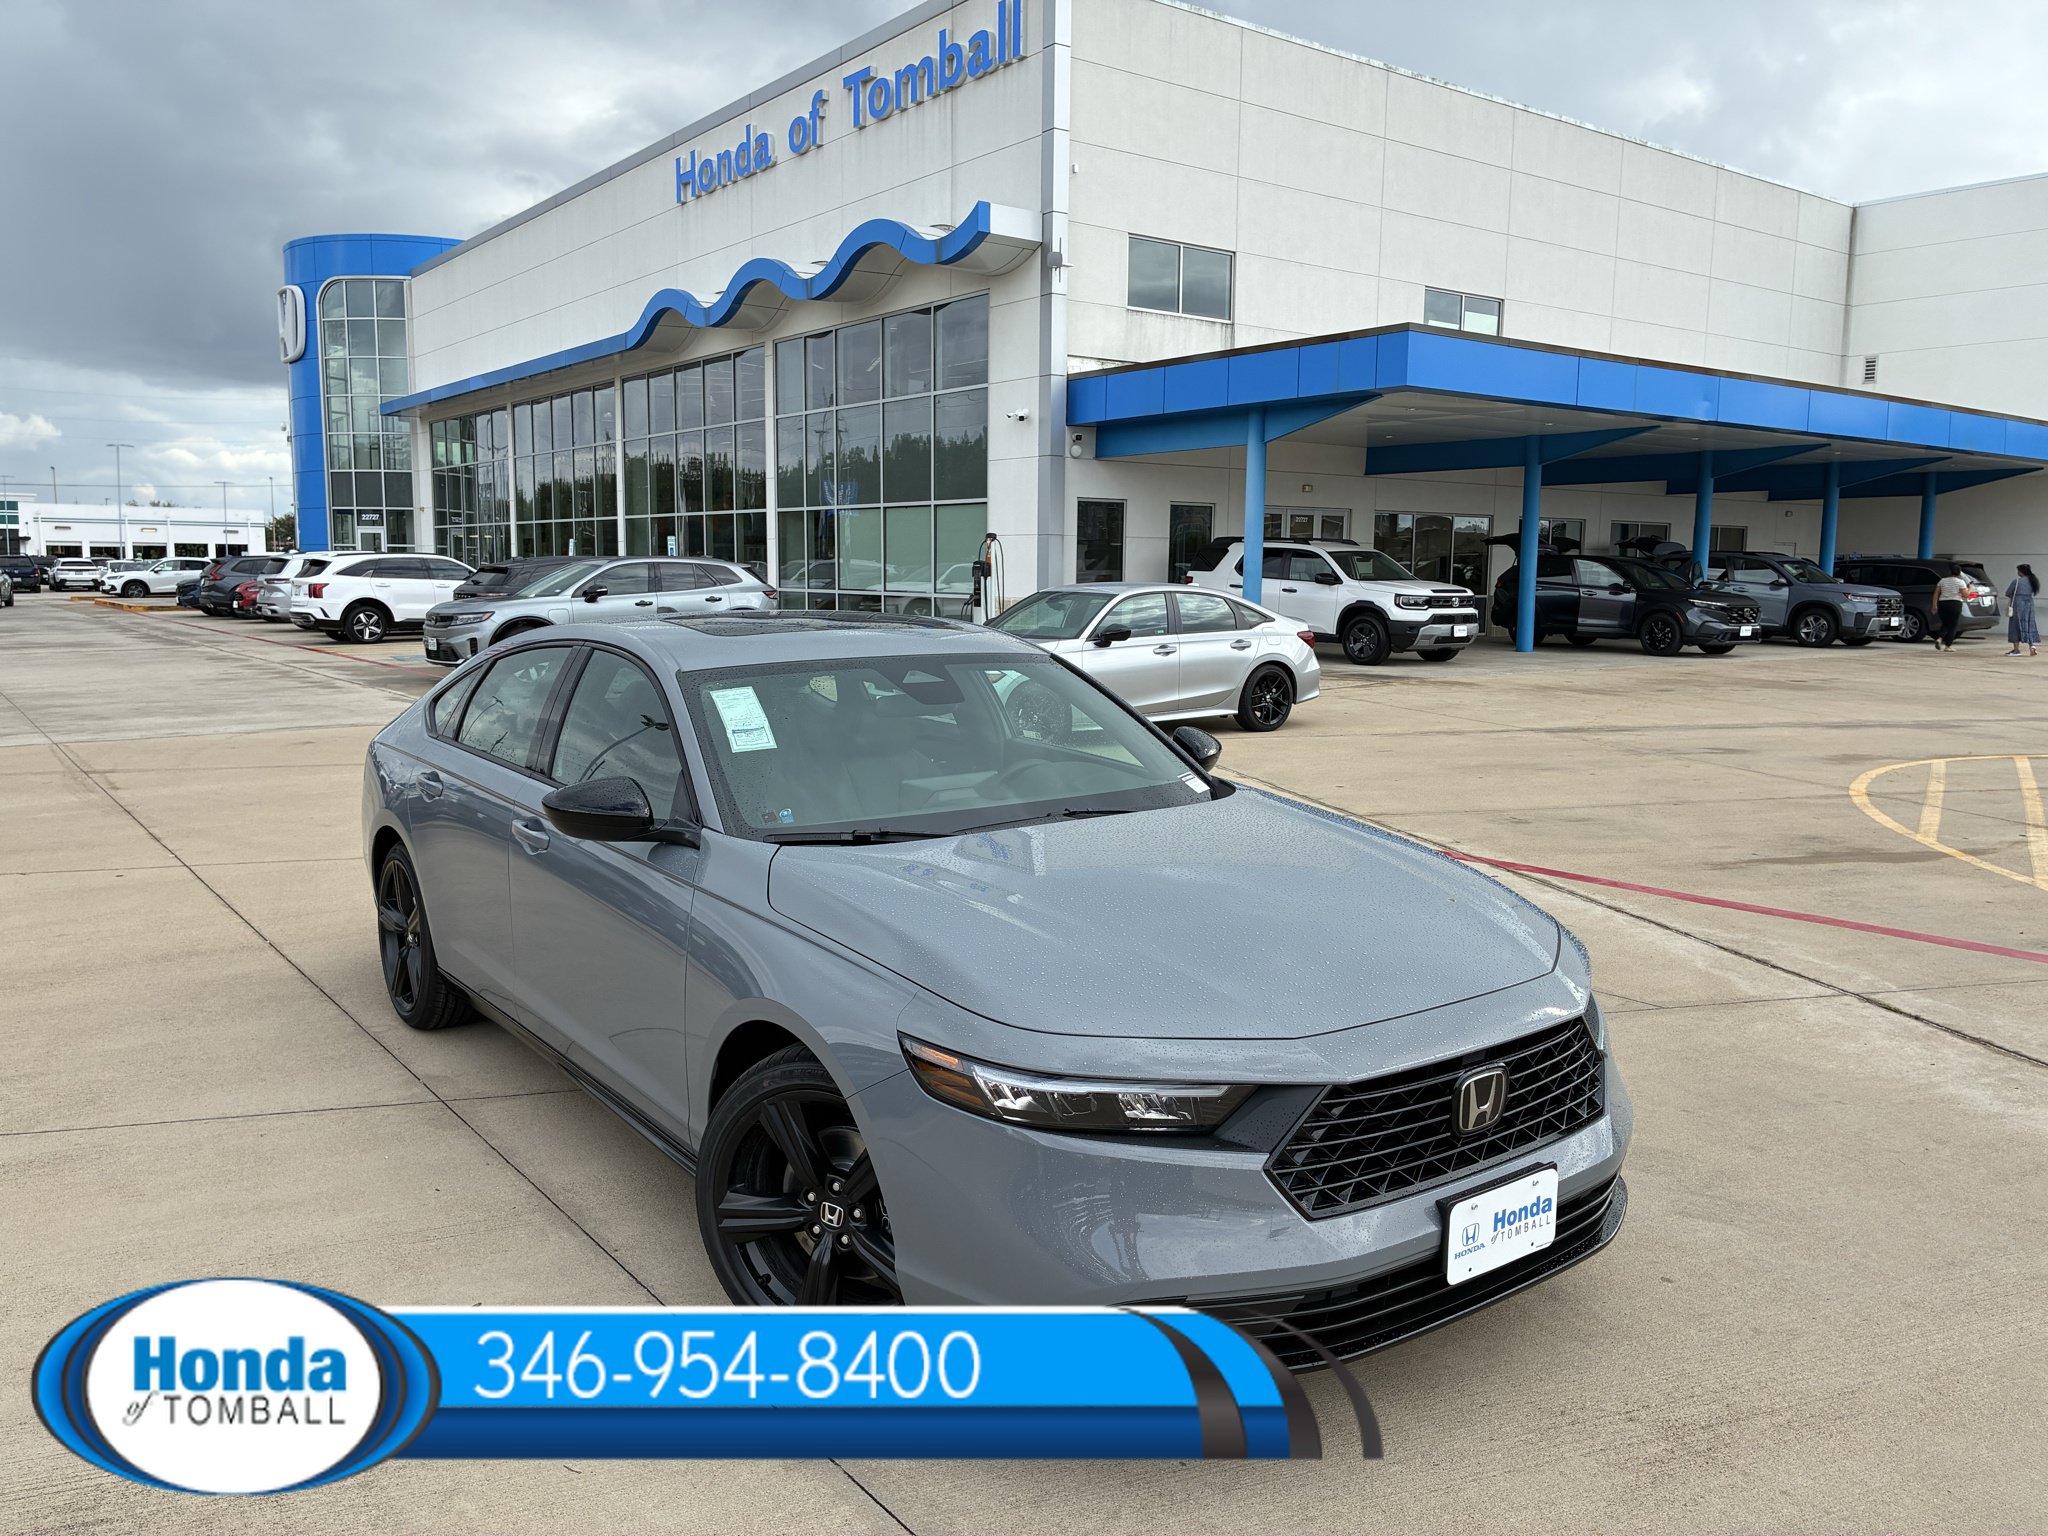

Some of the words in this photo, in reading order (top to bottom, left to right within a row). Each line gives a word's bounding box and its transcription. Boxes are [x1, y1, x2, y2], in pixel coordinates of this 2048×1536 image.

[675, 124, 776, 204] Honda
[788, 88, 829, 155] of
[842, 0, 1028, 130] Tomball
[361, 513, 380, 521] 22727
[1493, 1195, 1552, 1233] Honda
[1500, 1214, 1551, 1242] TOMBALL
[1454, 1242, 1486, 1260] HONDA
